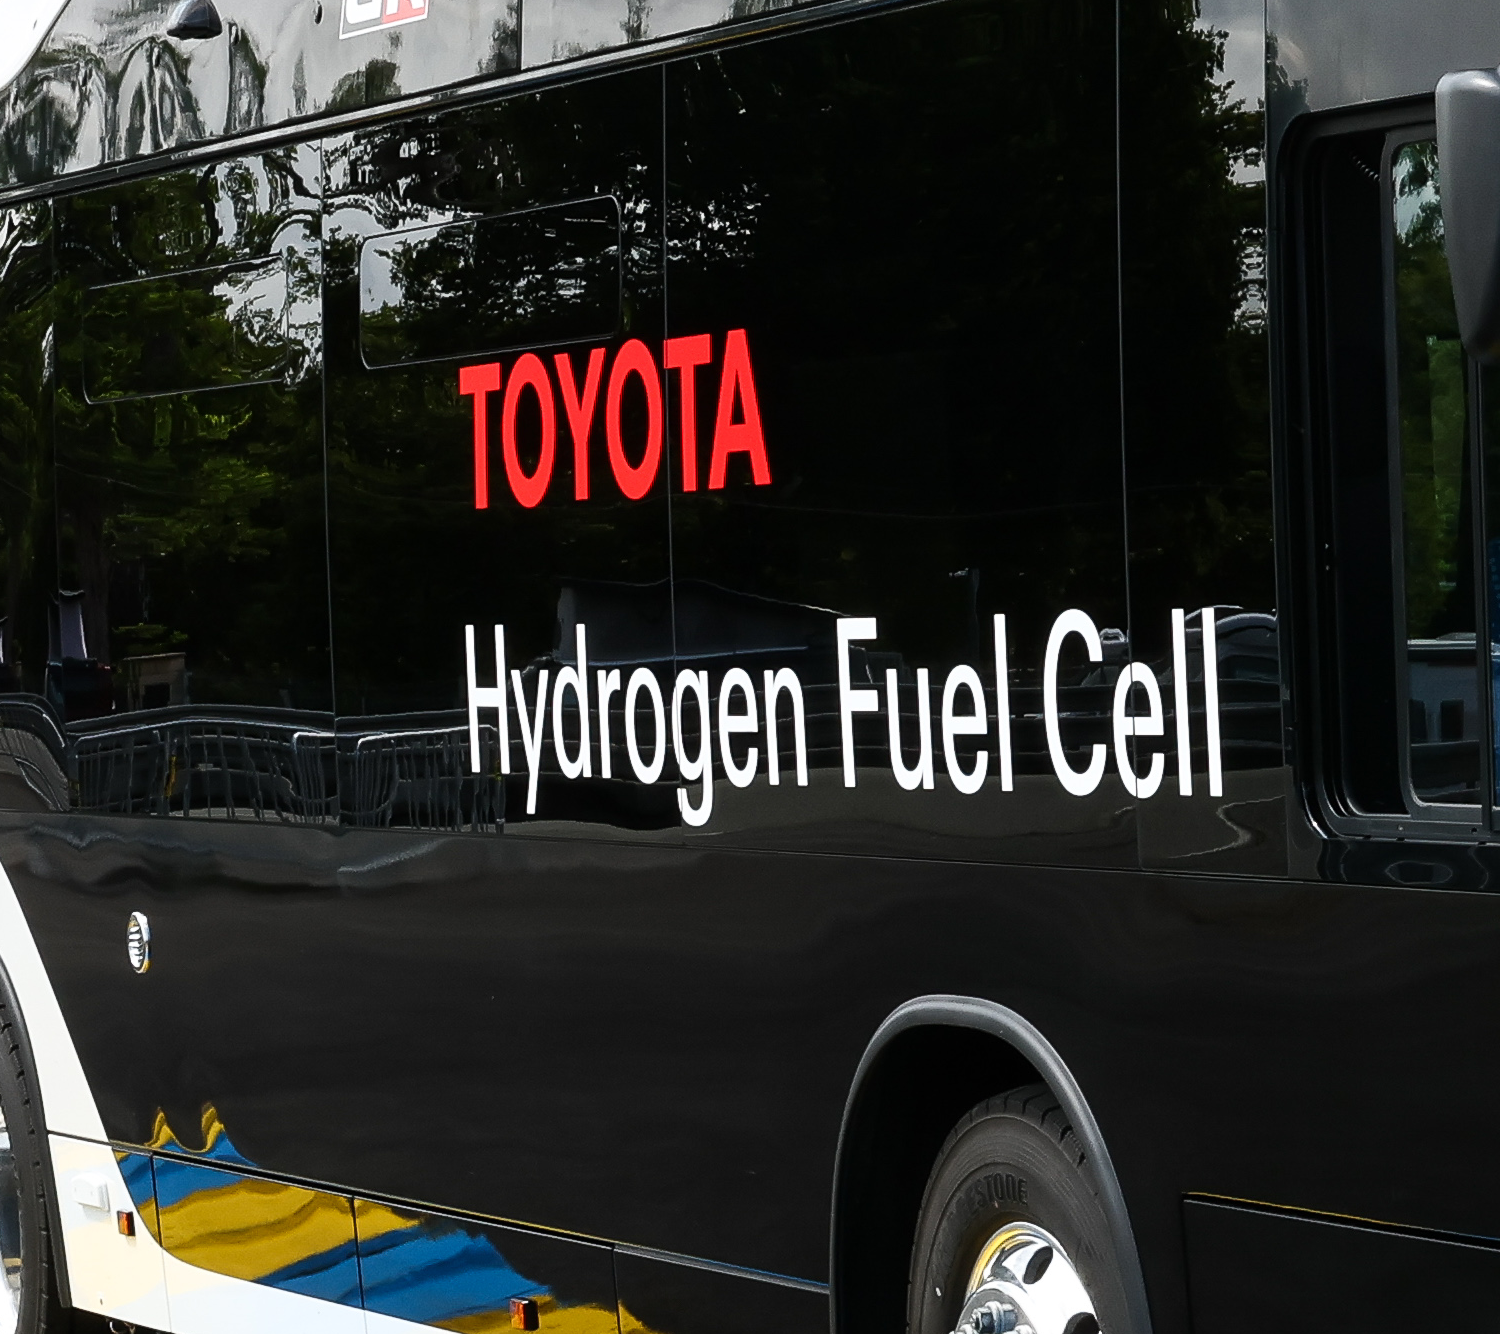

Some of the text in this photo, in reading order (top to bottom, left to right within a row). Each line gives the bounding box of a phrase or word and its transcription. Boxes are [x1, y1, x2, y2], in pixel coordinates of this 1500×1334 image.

[457, 327, 773, 510] TOYOTA
[465, 607, 1223, 827] Hydrogen Fuel Cell
